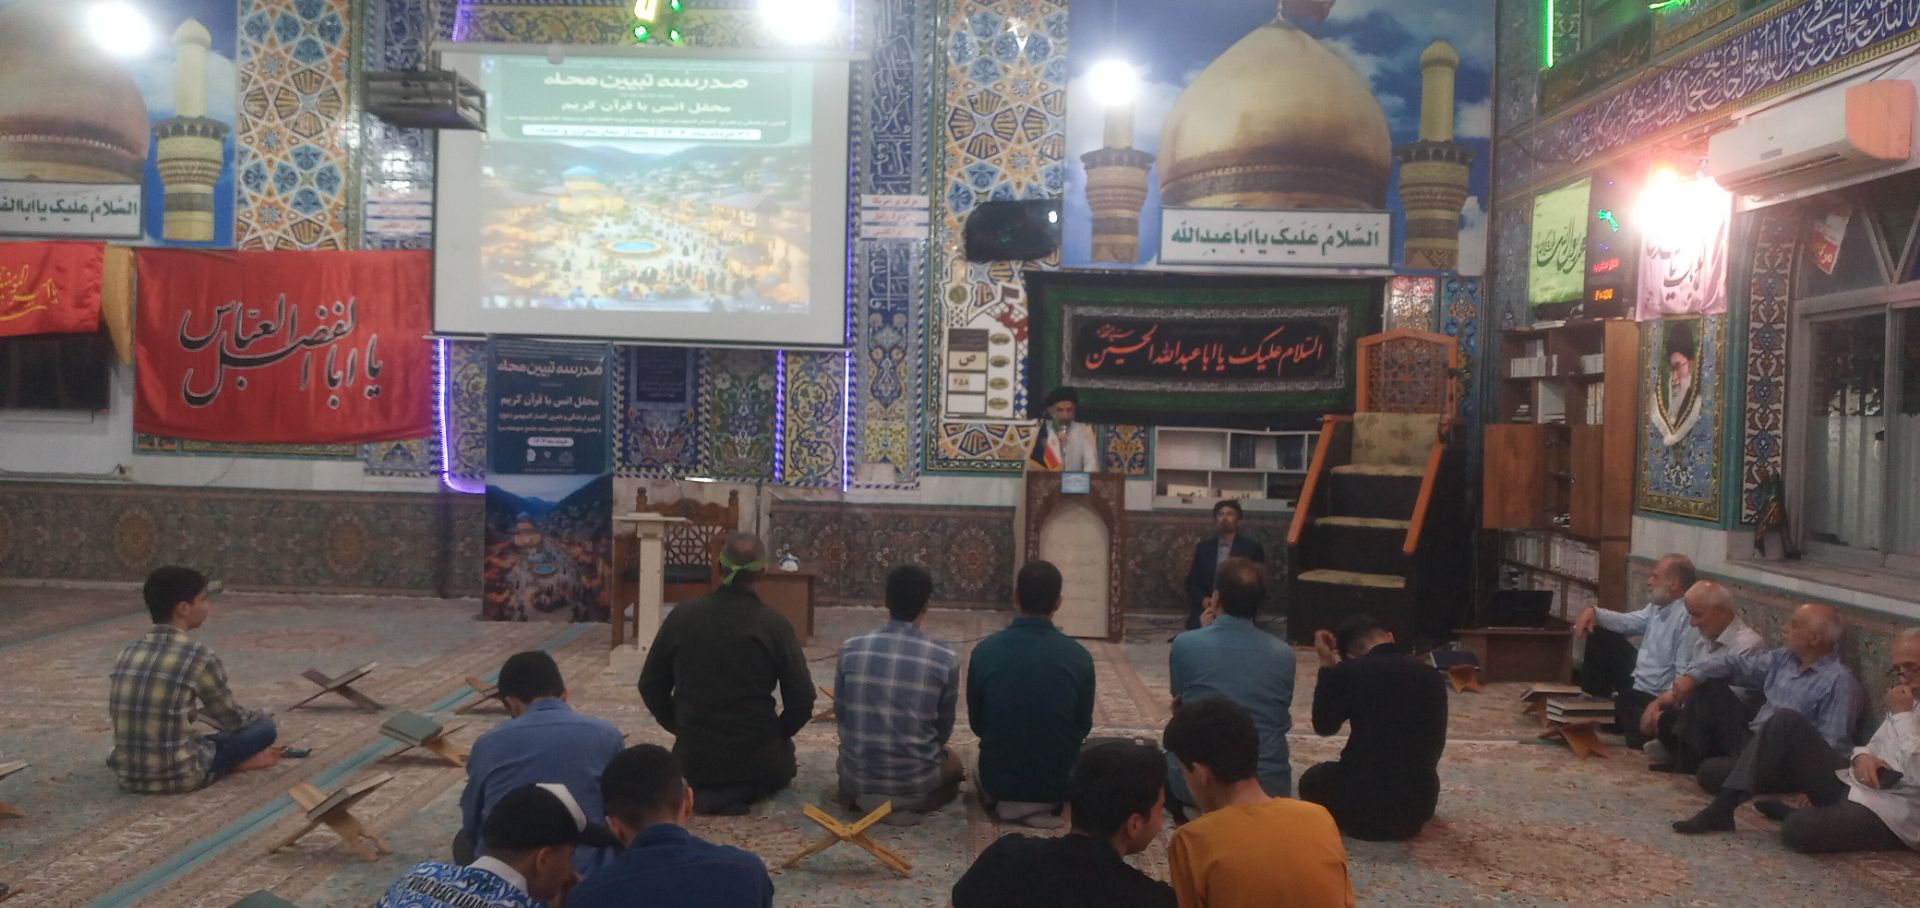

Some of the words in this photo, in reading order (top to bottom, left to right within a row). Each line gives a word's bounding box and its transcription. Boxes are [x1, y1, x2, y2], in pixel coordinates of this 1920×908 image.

[544, 72, 598, 86] محله
[657, 75, 748, 91] مدرسه
[561, 99, 597, 111] کریم
[600, 99, 633, 112] قرآن
[636, 101, 647, 112] با
[652, 101, 684, 114] انس
[688, 101, 731, 114] محفل
[958, 354, 976, 367] ص
[556, 364, 604, 378] مدرسه
[500, 394, 522, 406] کریم
[524, 392, 543, 408] قرآن
[544, 395, 552, 406] با
[553, 395, 573, 408] انس
[574, 395, 599, 408] محفل
